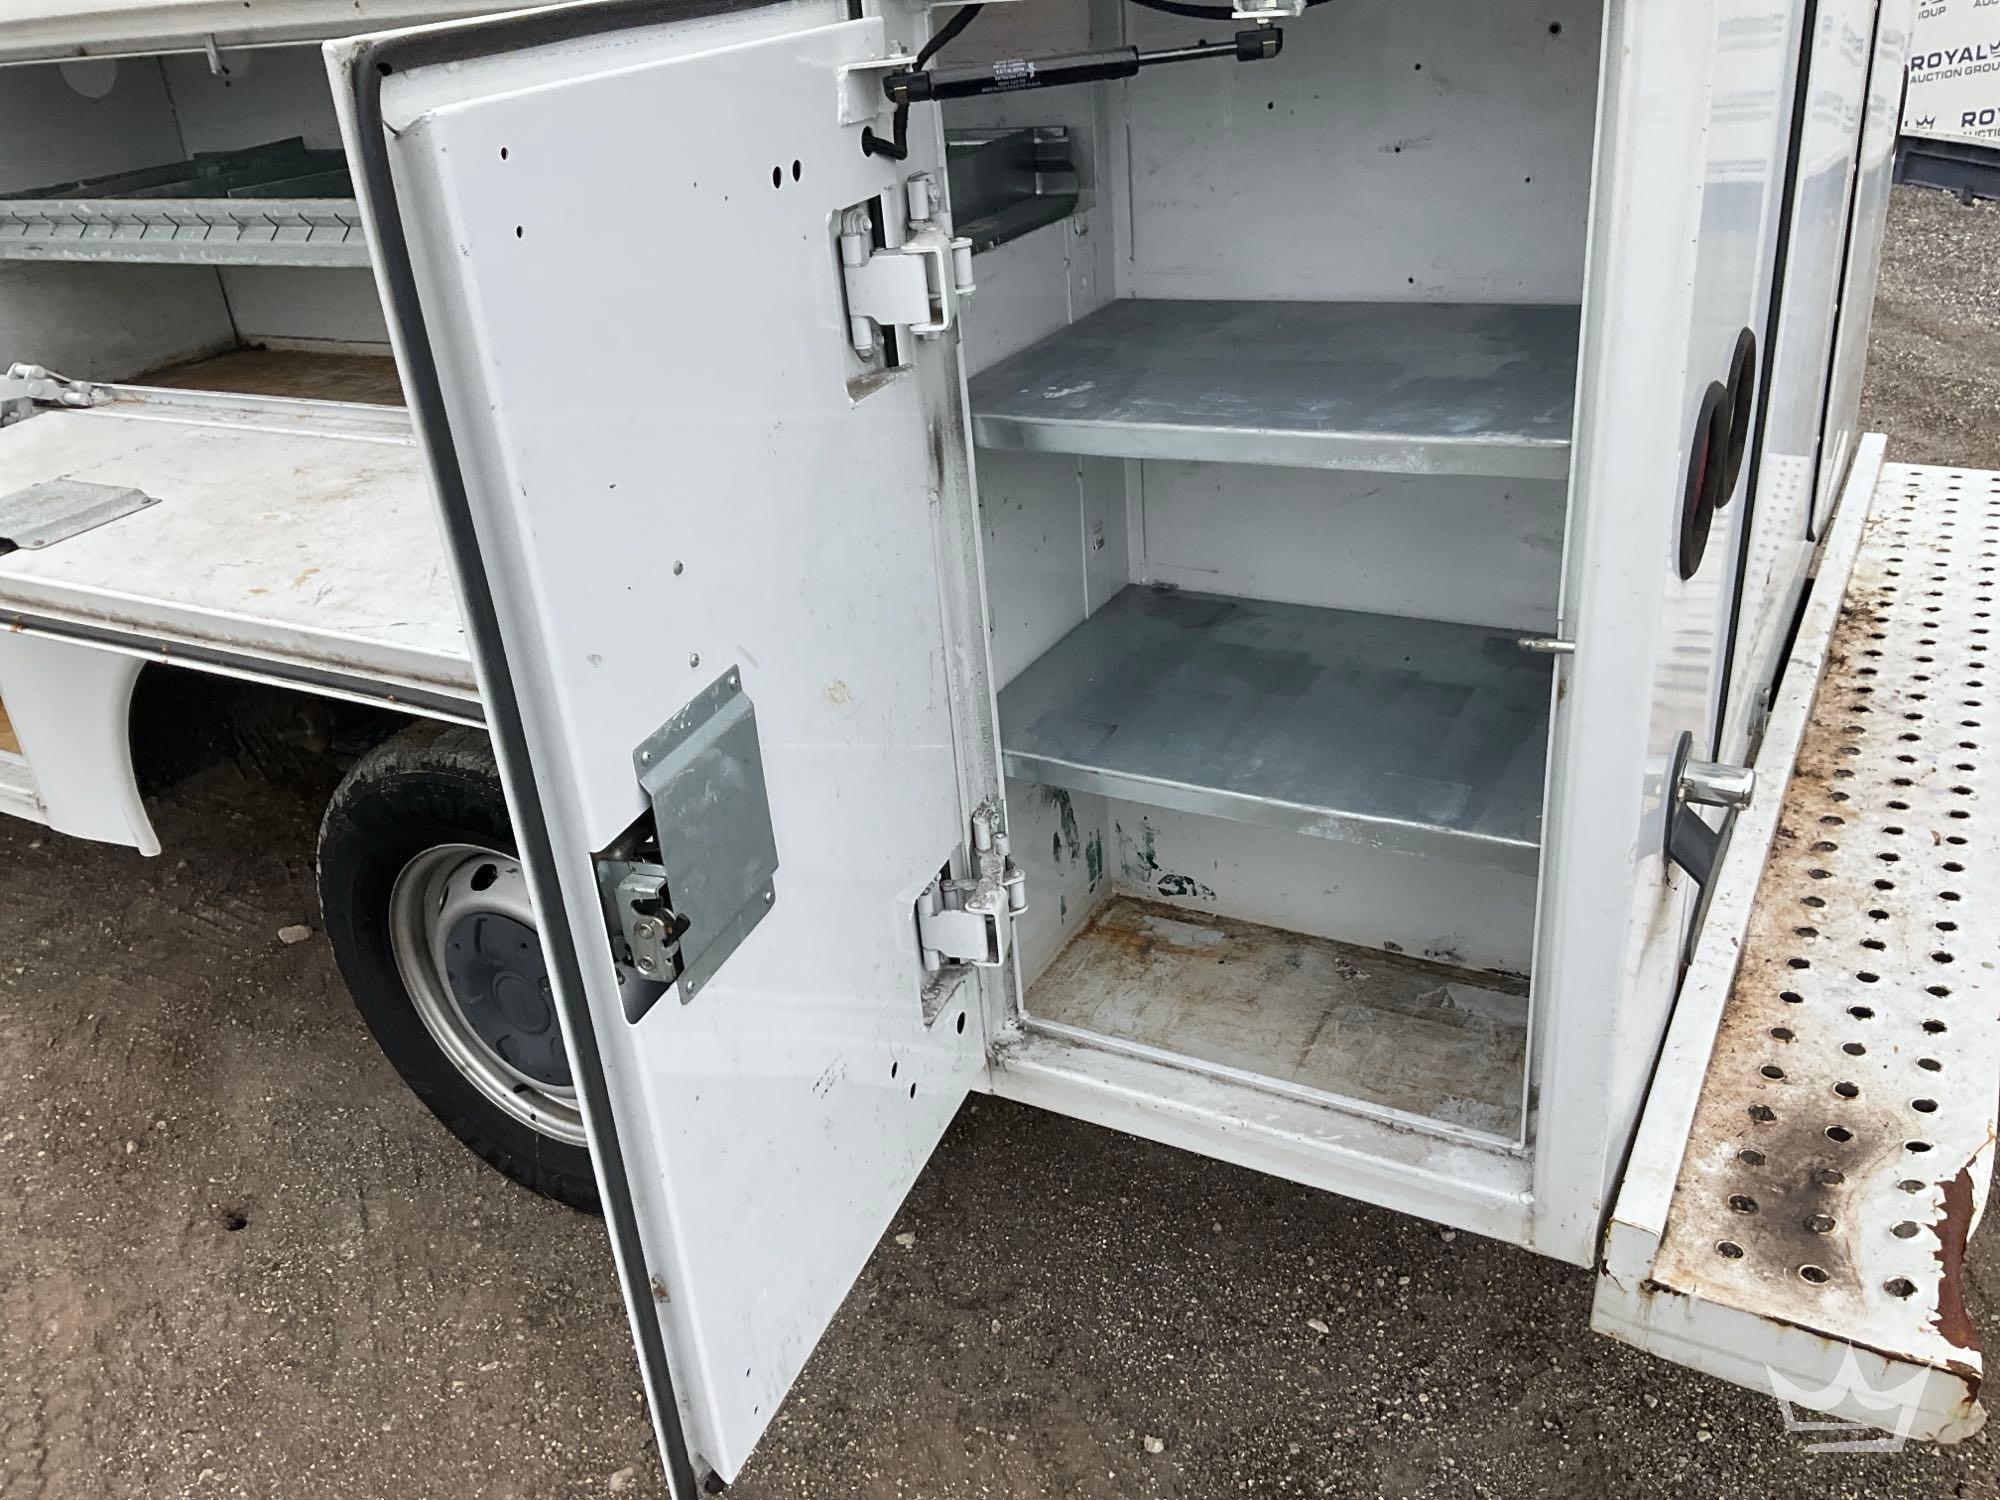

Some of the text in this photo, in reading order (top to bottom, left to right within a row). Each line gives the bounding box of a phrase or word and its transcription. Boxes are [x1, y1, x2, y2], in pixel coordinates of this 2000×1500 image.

[1910, 45, 1988, 72] ROYAL
[1909, 61, 2000, 84] AUCTION GROU
[1961, 107, 2000, 128] RO
